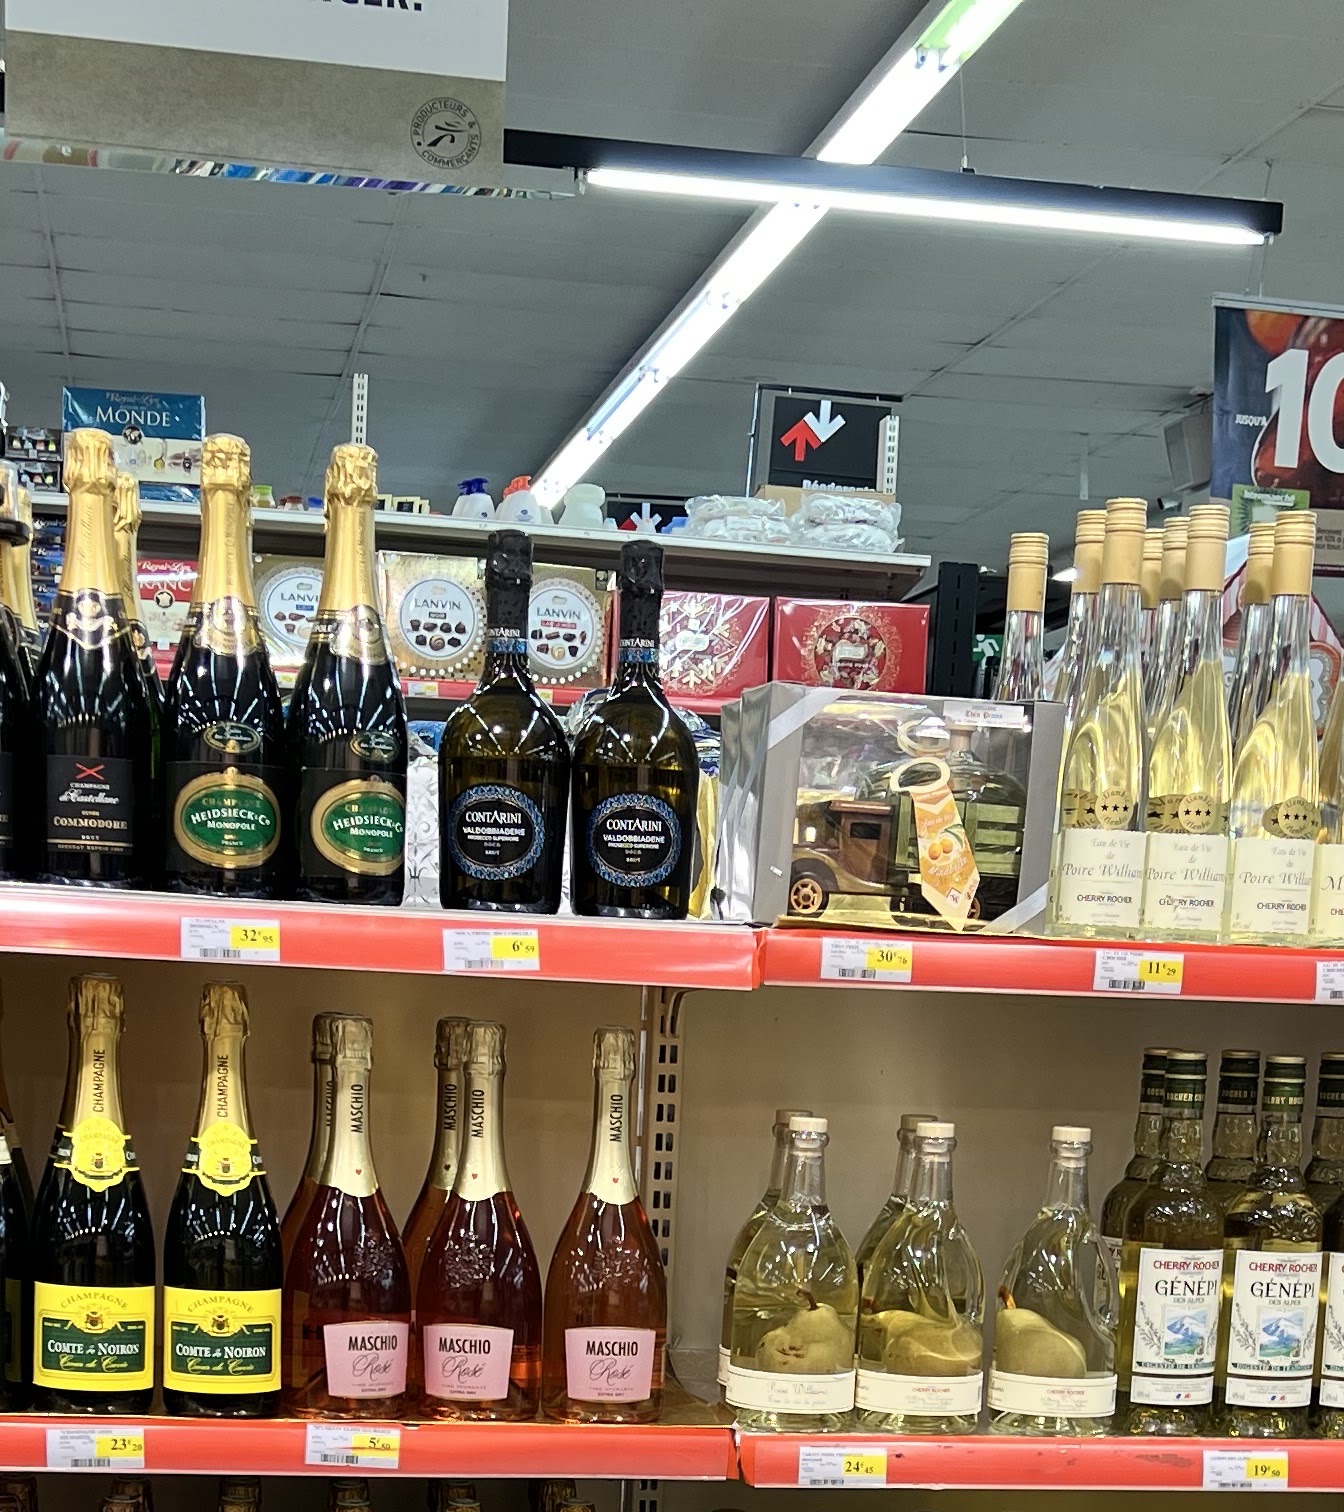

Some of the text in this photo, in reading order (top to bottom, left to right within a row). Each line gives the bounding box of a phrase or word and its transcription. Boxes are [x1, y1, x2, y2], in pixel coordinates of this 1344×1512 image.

[413, 100, 469, 136] PRODUCTEURS
[421, 134, 479, 167] COMMERÇANTS
[96, 406, 170, 427] MONDE
[207, 821, 255, 830] MONOPOLE
[466, 810, 521, 824] CONTARINI
[606, 818, 662, 832] CONTARINI
[1153, 1260, 1190, 1270] CHERRY
[1155, 1278, 1217, 1296] GÉNÉPI
[1250, 1278, 1315, 1298] GÉNÉPI
[61, 1292, 128, 1311] CHAMPAGNE
[188, 1294, 254, 1313] CHAMPAGNE
[48, 1340, 139, 1356] COMTE NOIRON
[176, 1344, 266, 1359] COMTE NOIRON
[348, 1335, 397, 1352] MASCHIO
[439, 1336, 491, 1355] MASCHIO
[586, 1340, 638, 1356] MASCHIO
